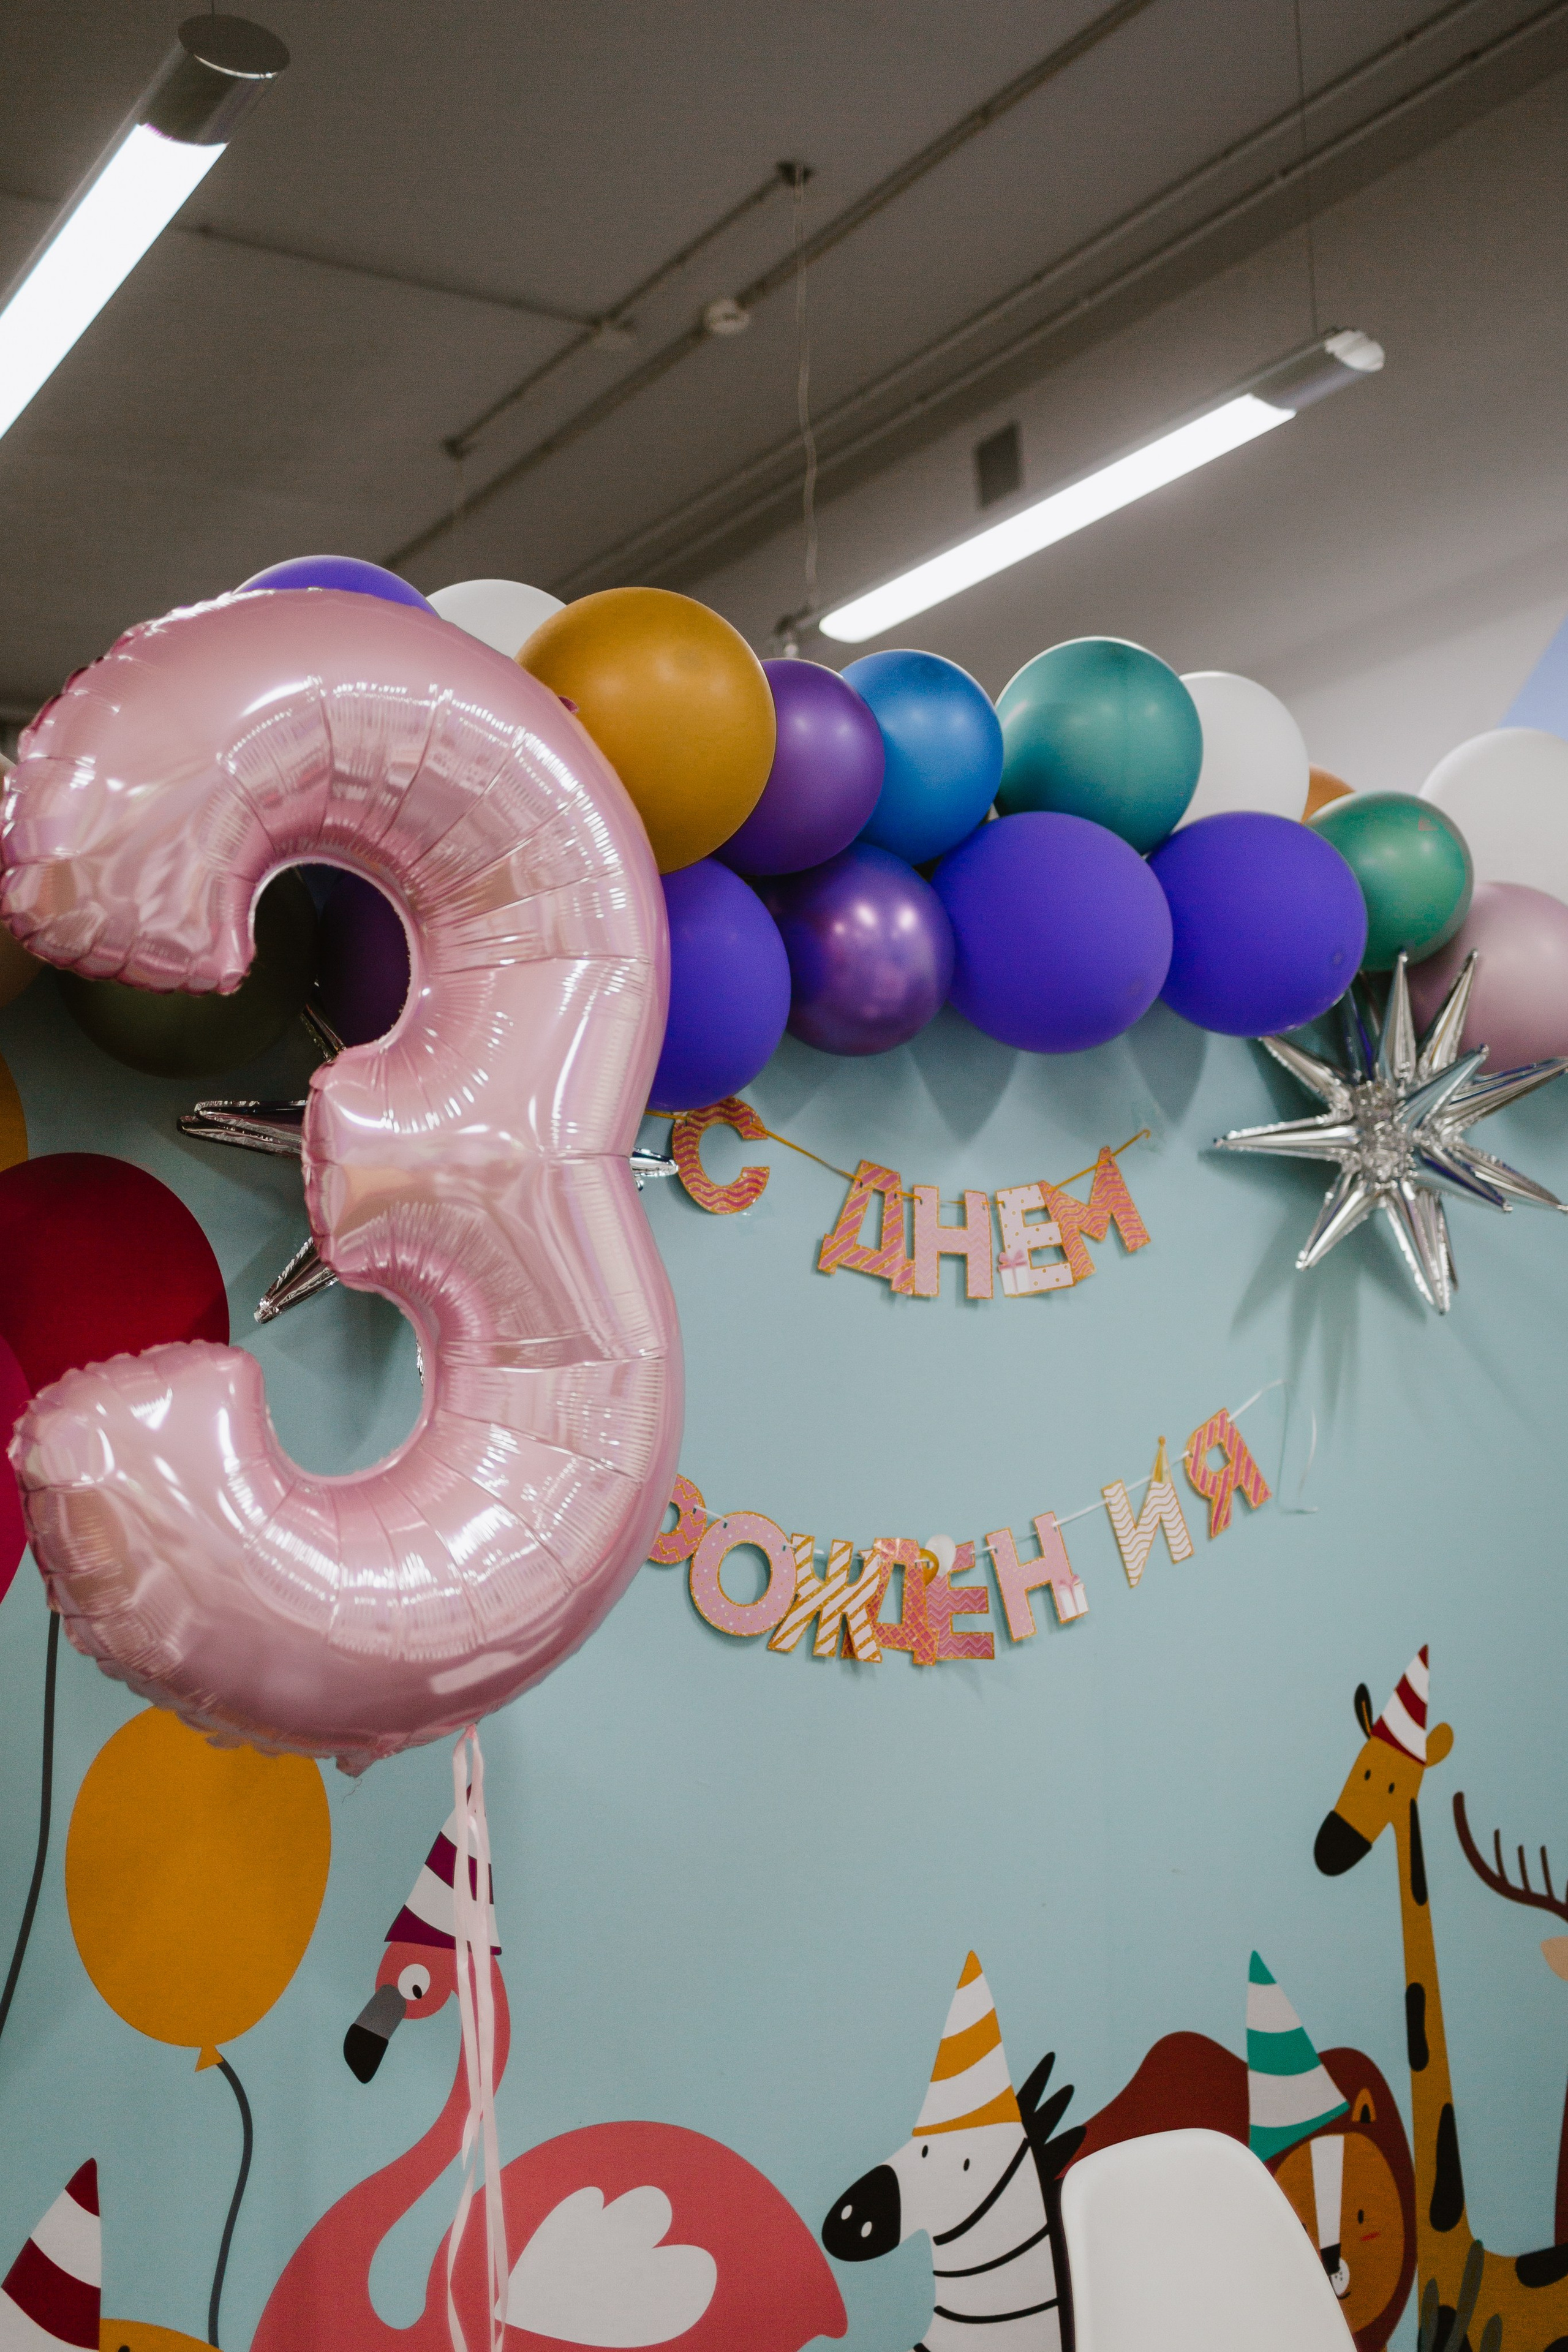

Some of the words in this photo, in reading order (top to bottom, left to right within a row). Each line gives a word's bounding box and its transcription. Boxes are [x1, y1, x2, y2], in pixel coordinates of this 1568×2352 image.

[1, 587, 684, 1775] 3
[673, 1096, 770, 1215] С
[818, 1146, 1151, 1299] ДНЕМ
